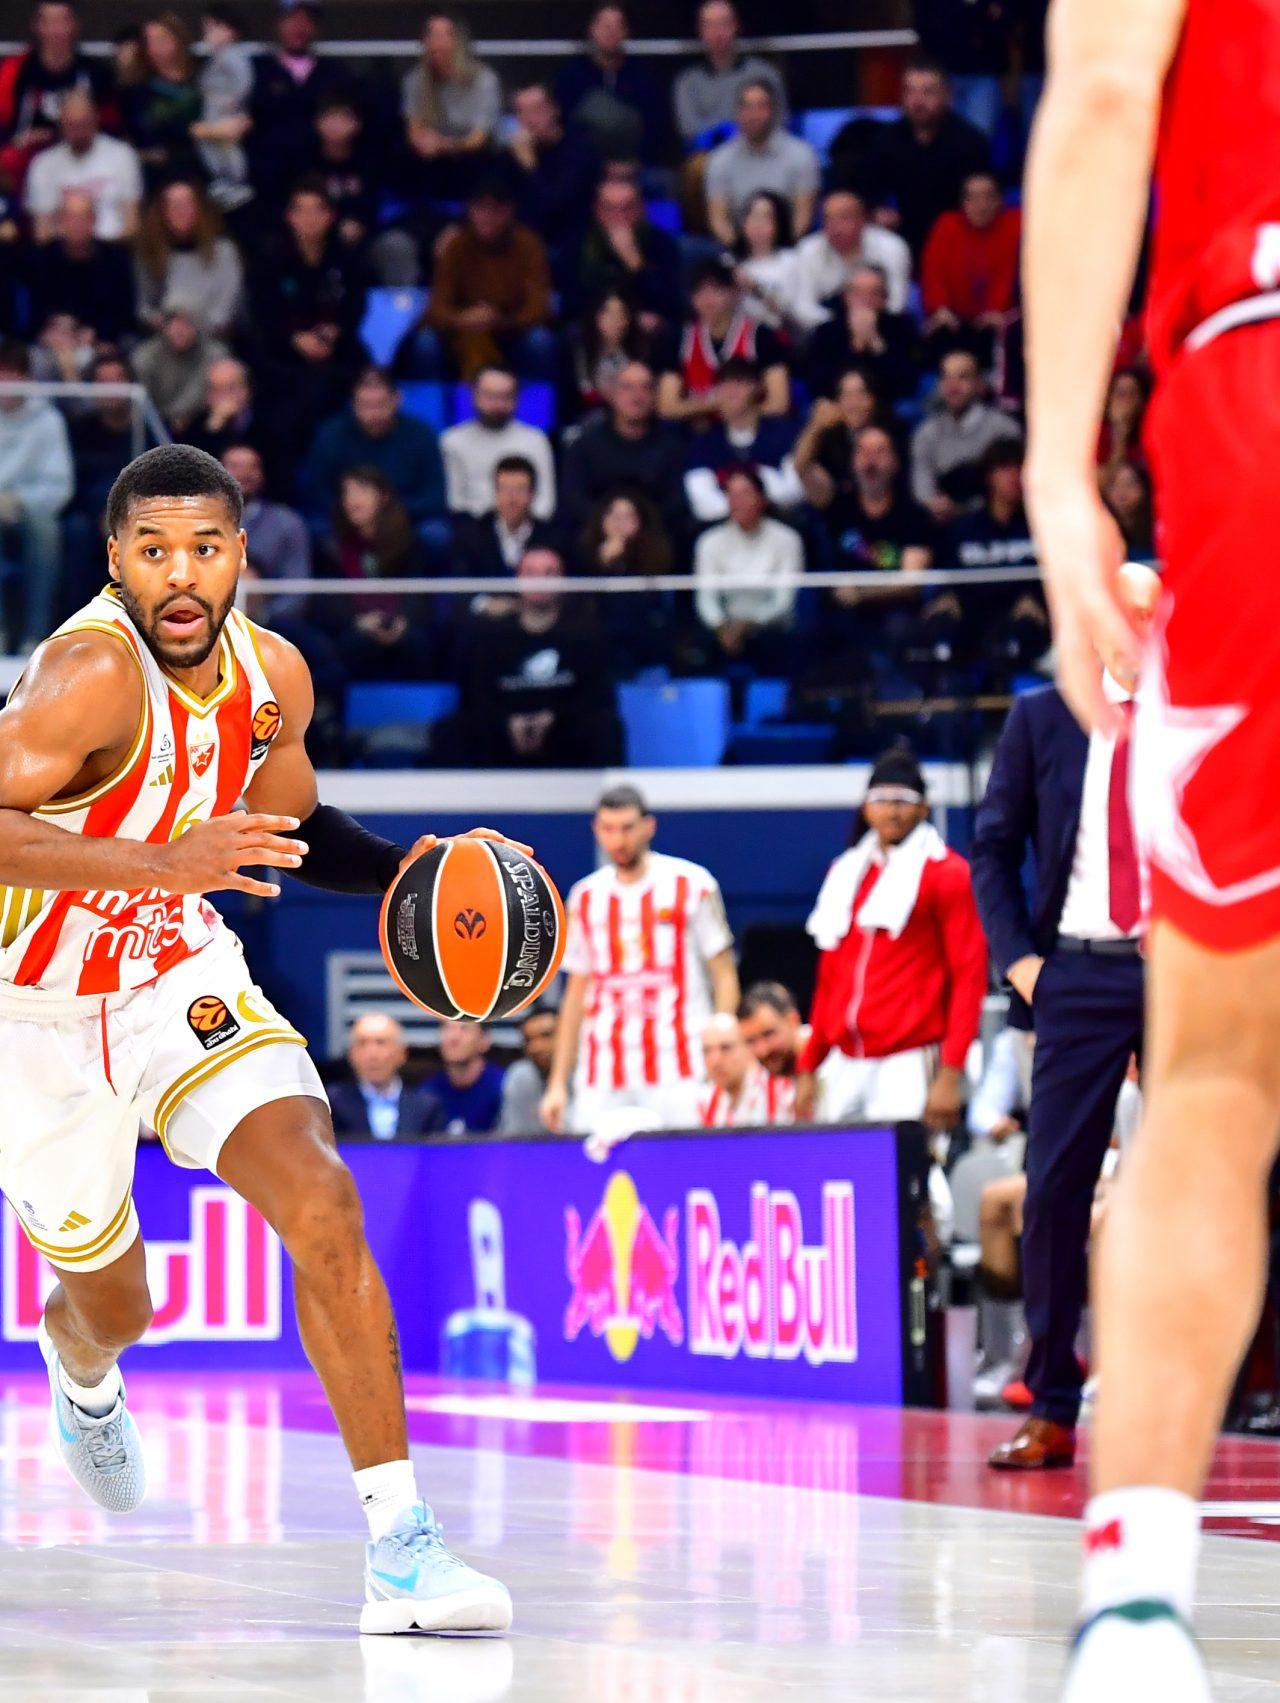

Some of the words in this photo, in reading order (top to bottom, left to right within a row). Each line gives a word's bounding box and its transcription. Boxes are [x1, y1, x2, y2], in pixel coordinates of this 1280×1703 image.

[502, 861, 541, 990] SPALDING
[687, 1180, 770, 1358] Red
[770, 1180, 859, 1367] Bull
